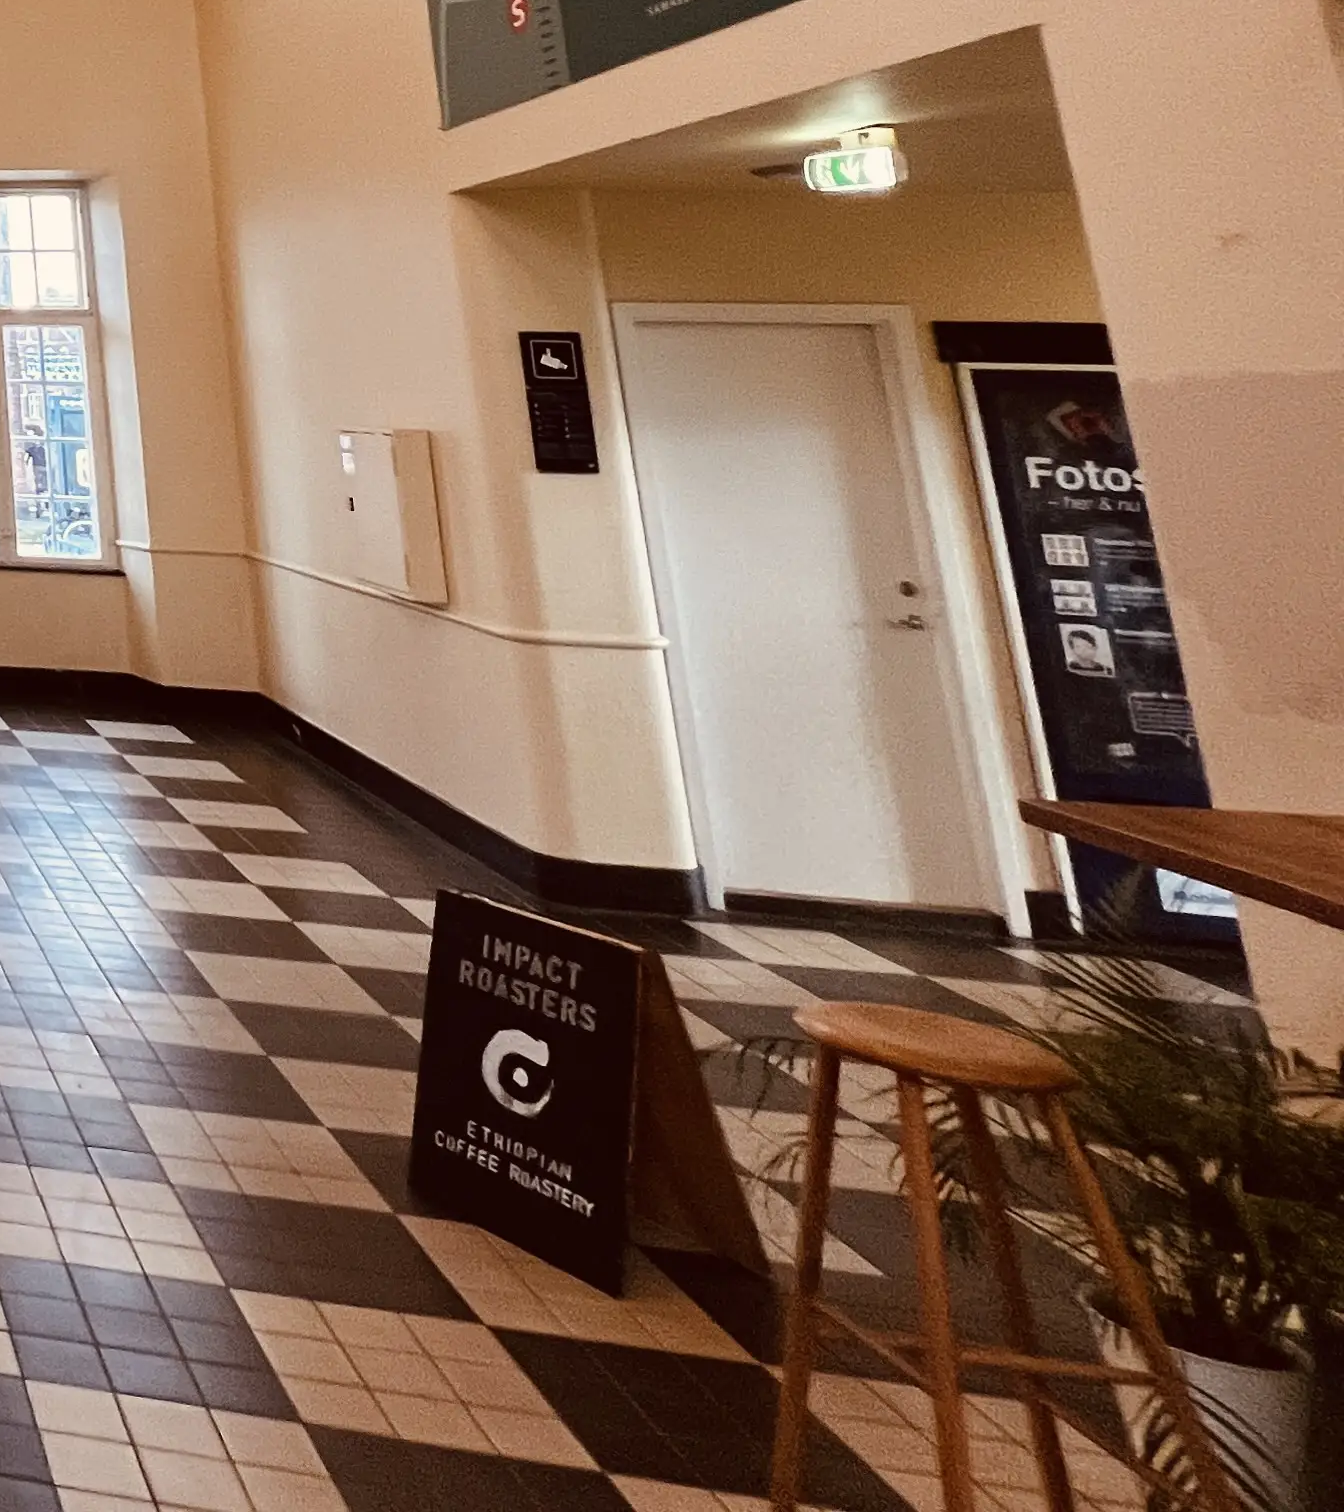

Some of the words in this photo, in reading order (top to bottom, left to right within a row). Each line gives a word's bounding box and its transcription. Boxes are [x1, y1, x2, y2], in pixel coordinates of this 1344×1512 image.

[458, 958, 598, 1033] ROASTERS
[482, 934, 584, 989] IMPACT
[433, 1130, 500, 1174] COFFEE
[508, 1162, 596, 1218] ROASTERY
[466, 1119, 573, 1183] ETHIOPIAN
